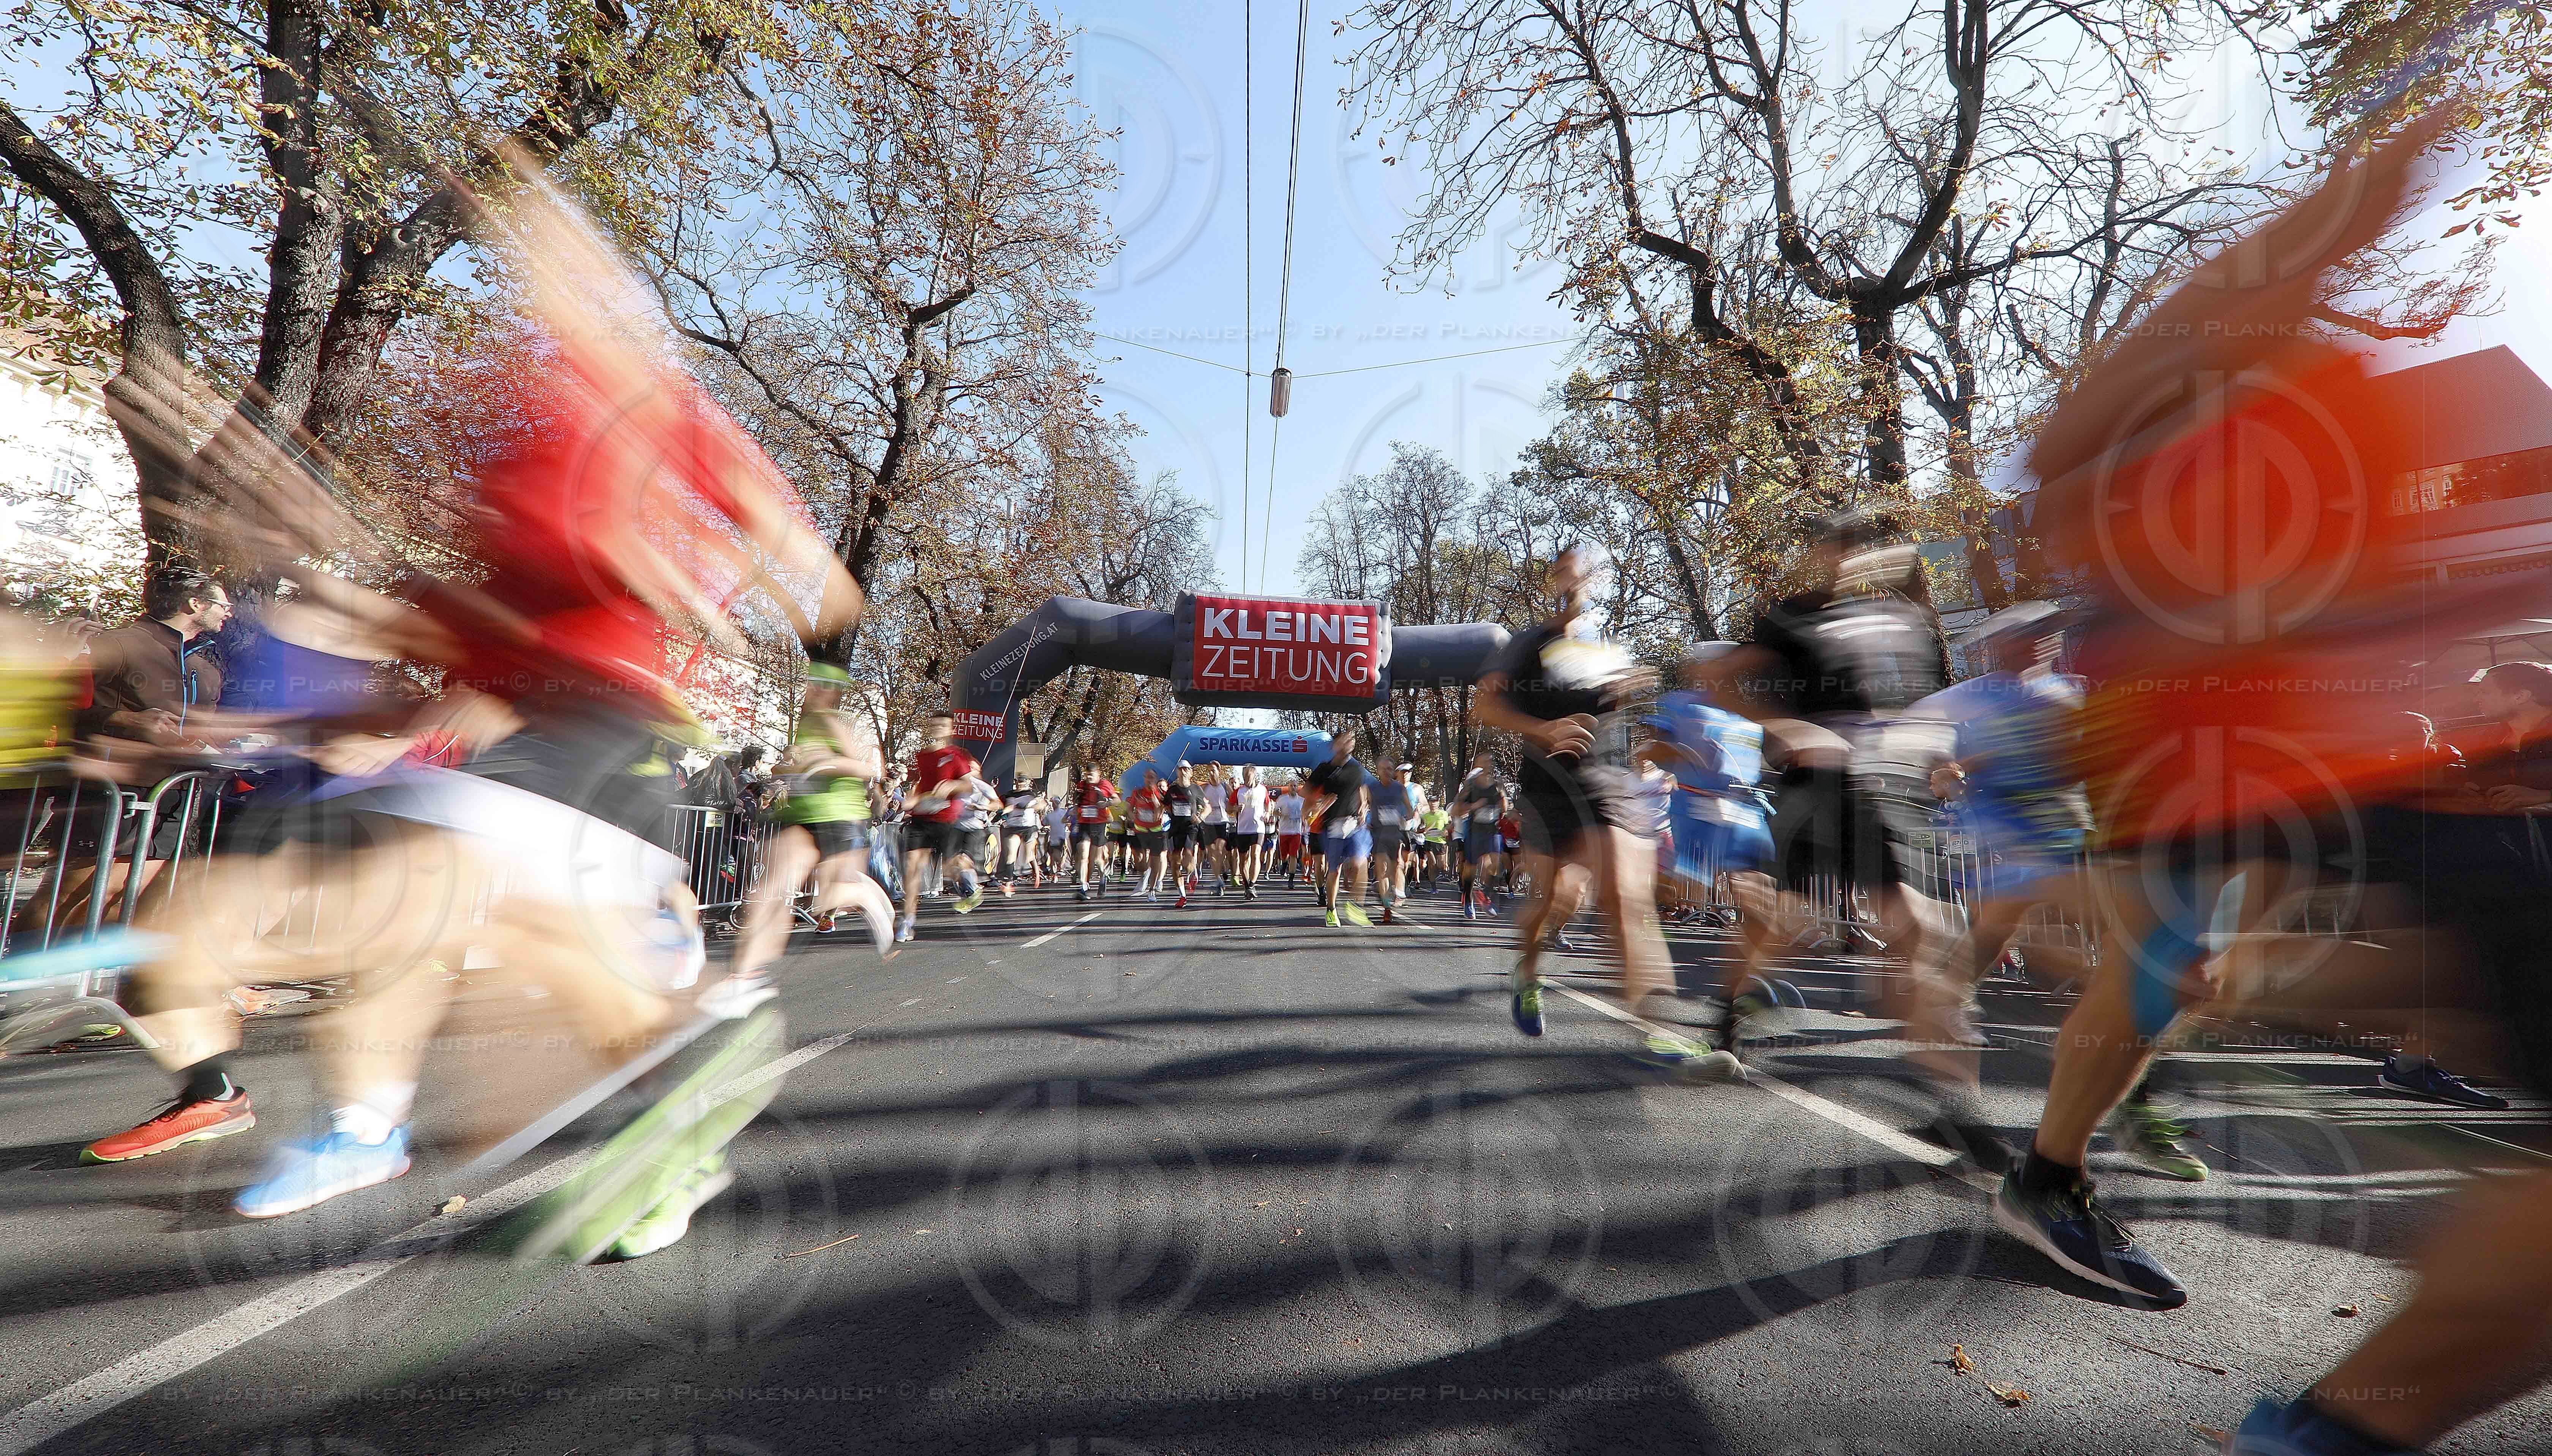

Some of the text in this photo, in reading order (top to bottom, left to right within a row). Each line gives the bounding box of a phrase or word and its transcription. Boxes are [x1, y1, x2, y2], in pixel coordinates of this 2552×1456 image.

[1203, 608, 1369, 646] KLEINE
[979, 622, 1059, 681] KLEINEZEITUNG.AT
[1202, 645, 1368, 684] ZEITUNG
[952, 724, 1003, 739] ZEITUNG
[953, 712, 1003, 727] KLEINE
[1200, 737, 1290, 753] SPARKASSE
